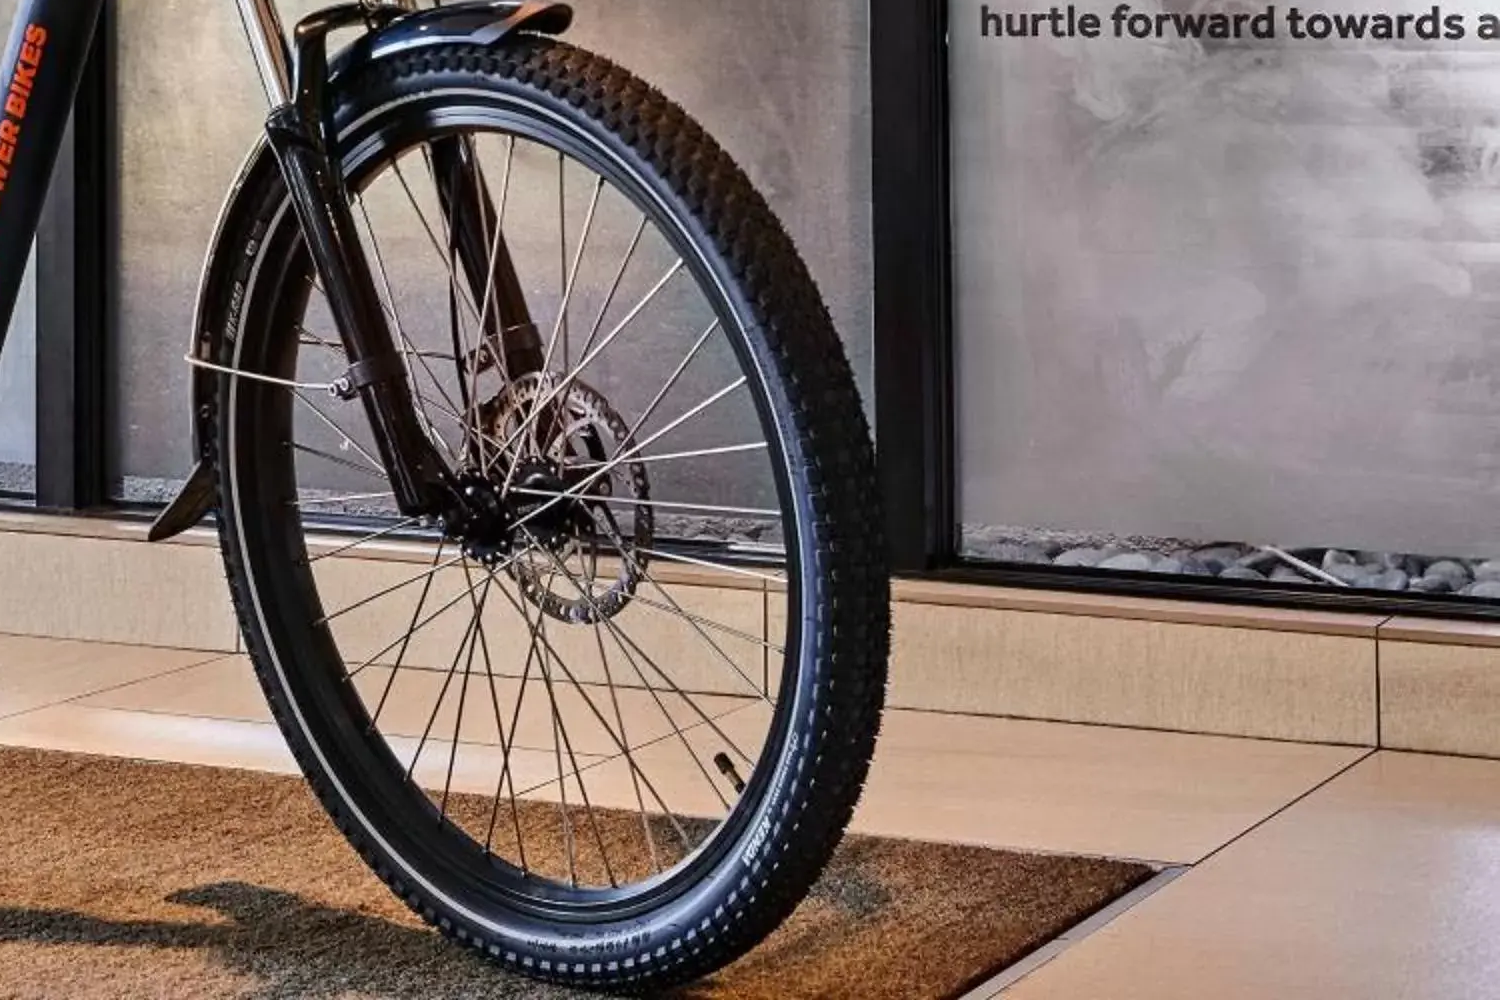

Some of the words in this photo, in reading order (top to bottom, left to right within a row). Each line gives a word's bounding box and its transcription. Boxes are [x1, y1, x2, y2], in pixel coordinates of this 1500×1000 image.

[980, 4, 1101, 39] hurtle
[1110, 3, 1276, 40] forward
[1285, 5, 1465, 41] towards
[5, 23, 47, 119] BIKES
